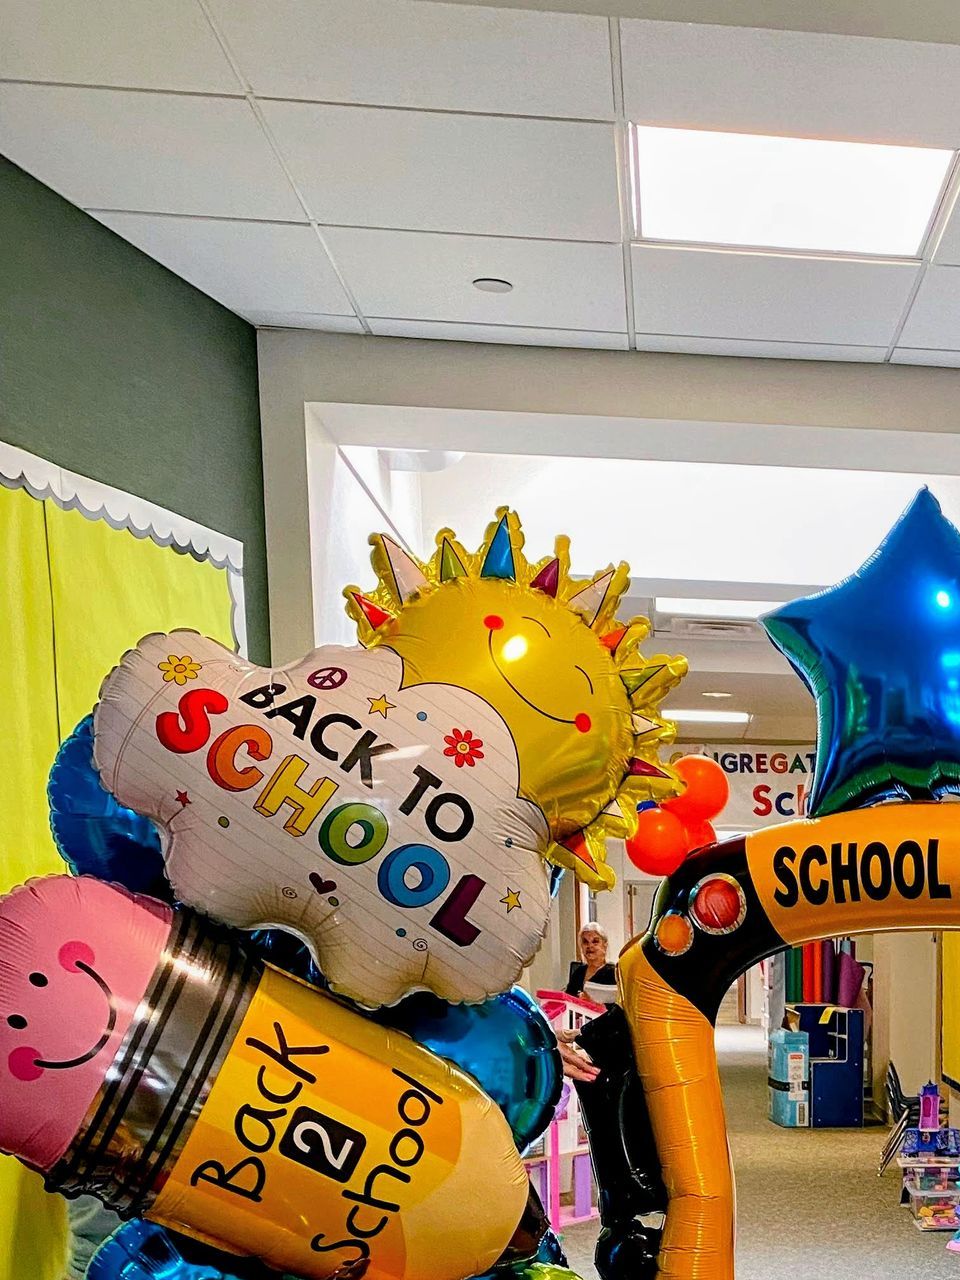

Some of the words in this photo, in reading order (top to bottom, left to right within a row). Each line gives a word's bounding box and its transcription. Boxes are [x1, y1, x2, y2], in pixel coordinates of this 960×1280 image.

[156, 688, 488, 948] SCHOOL
[239, 682, 396, 789] BACK
[399, 764, 475, 843] TO
[669, 751, 818, 774] GREGAT
[773, 837, 953, 907] SCHOOL
[191, 1021, 331, 1203] Back
[292, 1120, 355, 1171] 2
[310, 1067, 444, 1268] School
